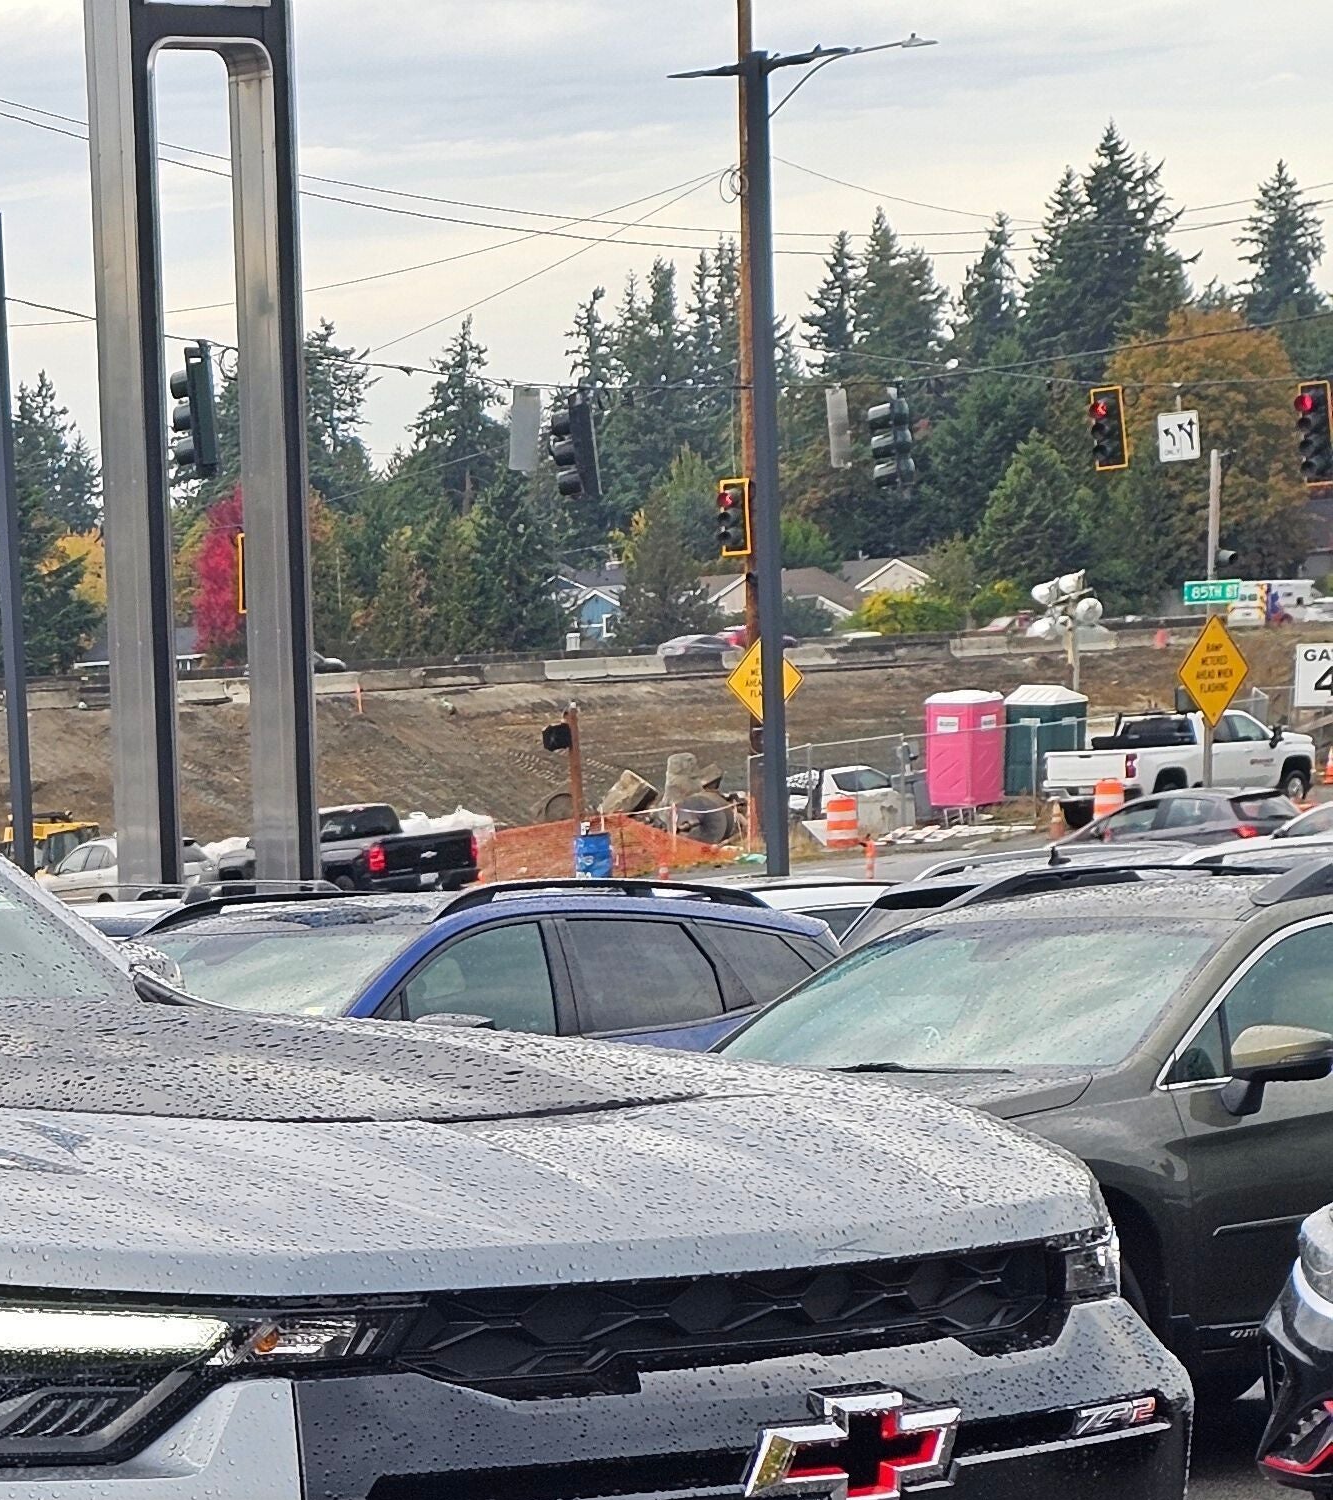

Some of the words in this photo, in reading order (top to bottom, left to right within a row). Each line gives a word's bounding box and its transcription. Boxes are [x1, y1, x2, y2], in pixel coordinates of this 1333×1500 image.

[1191, 585, 1223, 600] 85TH
[1303, 648, 1333, 662] GA
[1074, 1396, 1156, 1437] ZR2
